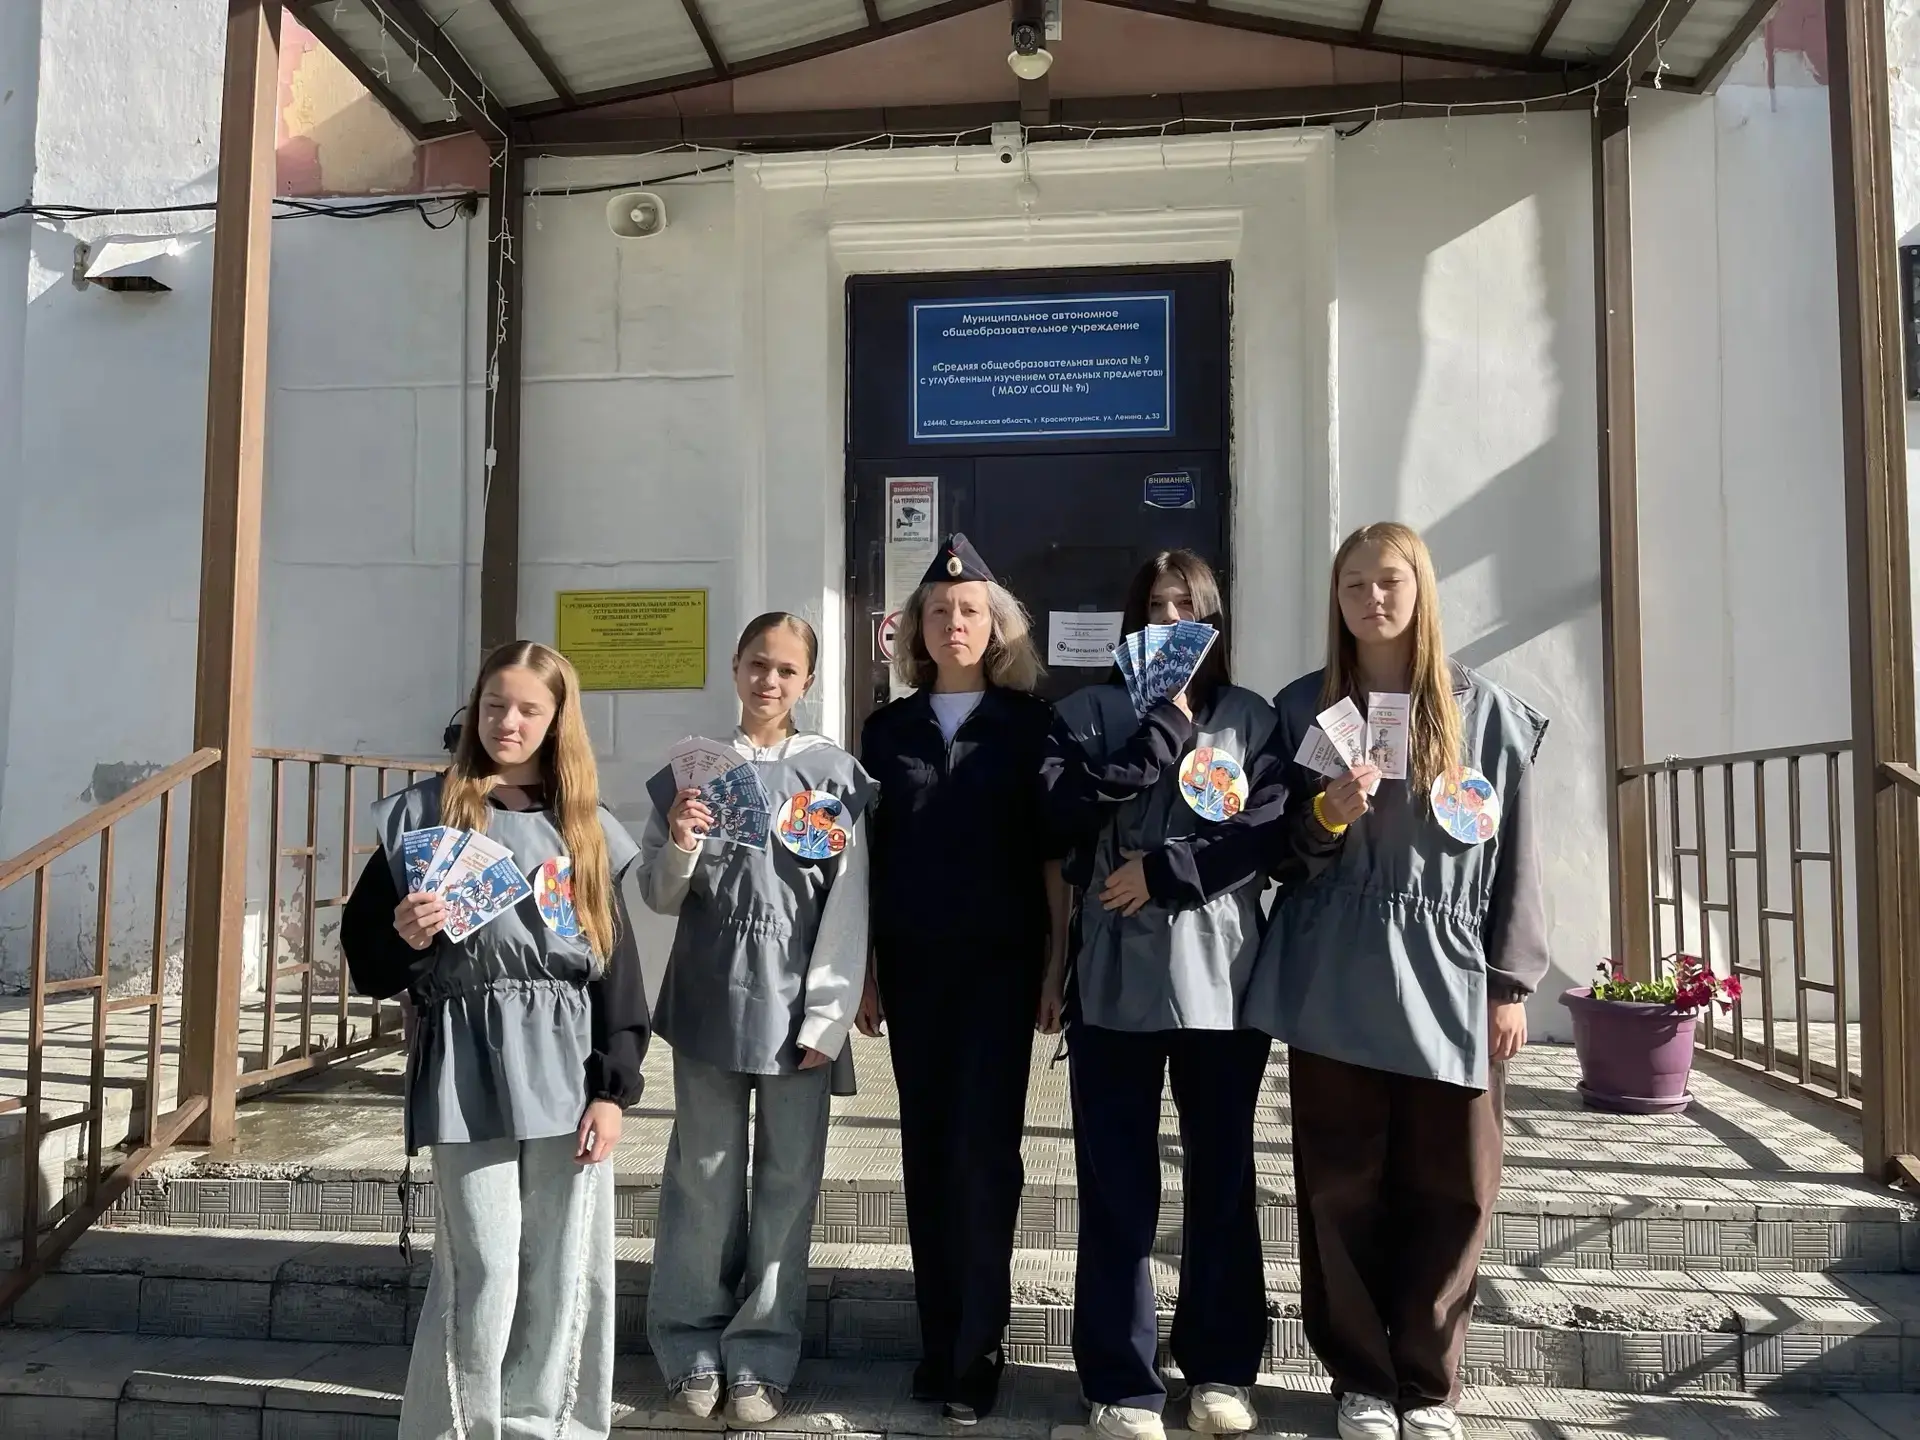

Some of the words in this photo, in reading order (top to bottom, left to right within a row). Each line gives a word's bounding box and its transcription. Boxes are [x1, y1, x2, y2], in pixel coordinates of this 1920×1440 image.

[962, 313, 1049, 325] Муниципальное
[1051, 310, 1119, 320] автономное
[942, 324, 1069, 337] общеобразовательное
[1071, 322, 1140, 334] учреждение
[932, 362, 979, 373] «Средняя
[980, 359, 1094, 371] общеобразовательная
[1095, 357, 1128, 366] школа
[1130, 355, 1142, 365] №
[1144, 355, 1150, 364] 9
[920, 377, 926, 385] с
[928, 374, 992, 387] углубленным
[994, 373, 1047, 383] изучением
[1048, 370, 1101, 381] отдельных
[1103, 369, 1164, 380] предметов»
[998, 385, 1028, 395] МАОУ
[1030, 384, 1060, 394] «СОШ
[1062, 383, 1074, 393] №
[1148, 476, 1191, 484] ВНИМАНИЕ
